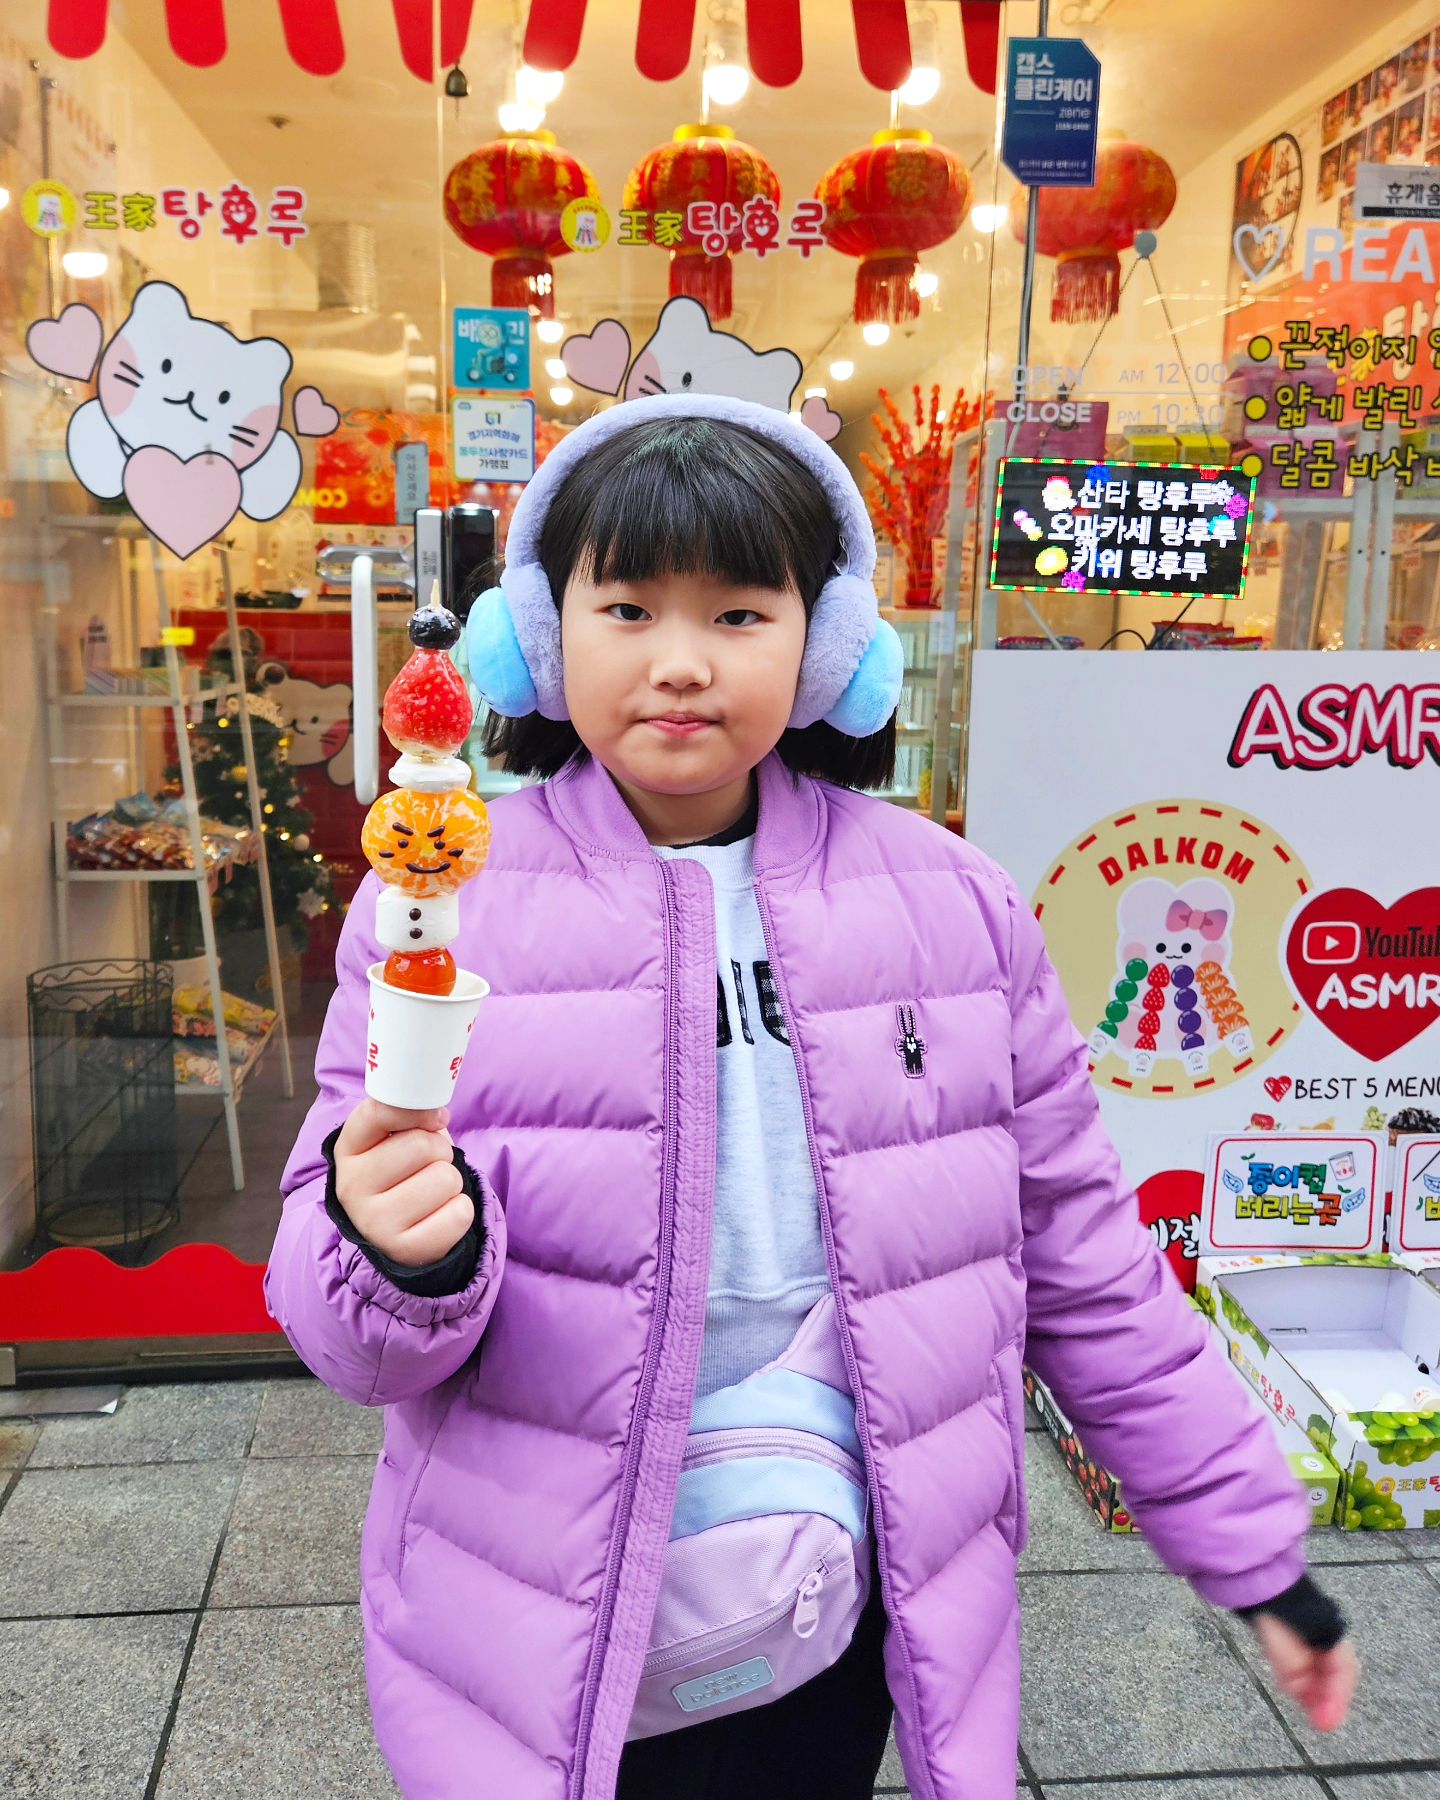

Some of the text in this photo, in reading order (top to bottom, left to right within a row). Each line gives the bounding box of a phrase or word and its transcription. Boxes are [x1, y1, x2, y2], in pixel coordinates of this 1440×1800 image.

[1016, 53, 1056, 75] 캡스
[1015, 78, 1094, 102] 클린케어
[1059, 107, 1091, 119] zone
[1280, 321, 1417, 370] 끈적이지
[1012, 363, 1227, 386] OPEN AM 12:00
[1007, 403, 1092, 423] CLOSE
[1117, 410, 1141, 424] PM
[1276, 382, 1422, 431] 얇게 발린
[1271, 441, 1339, 488] 달콤
[1348, 446, 1420, 487] 바삭
[1077, 480, 1214, 513] 산타 탕후루
[1048, 513, 1237, 548] 오마카세 탕후루
[1071, 549, 1208, 582] 키위 탕후루
[1227, 683, 1440, 771] ASMR
[1098, 836, 1254, 886] DALKOM
[1316, 972, 1440, 1011] ASMR
[1295, 1076, 1440, 1100] BEST 5 MEN
[1248, 1162, 1327, 1195] 종이컵
